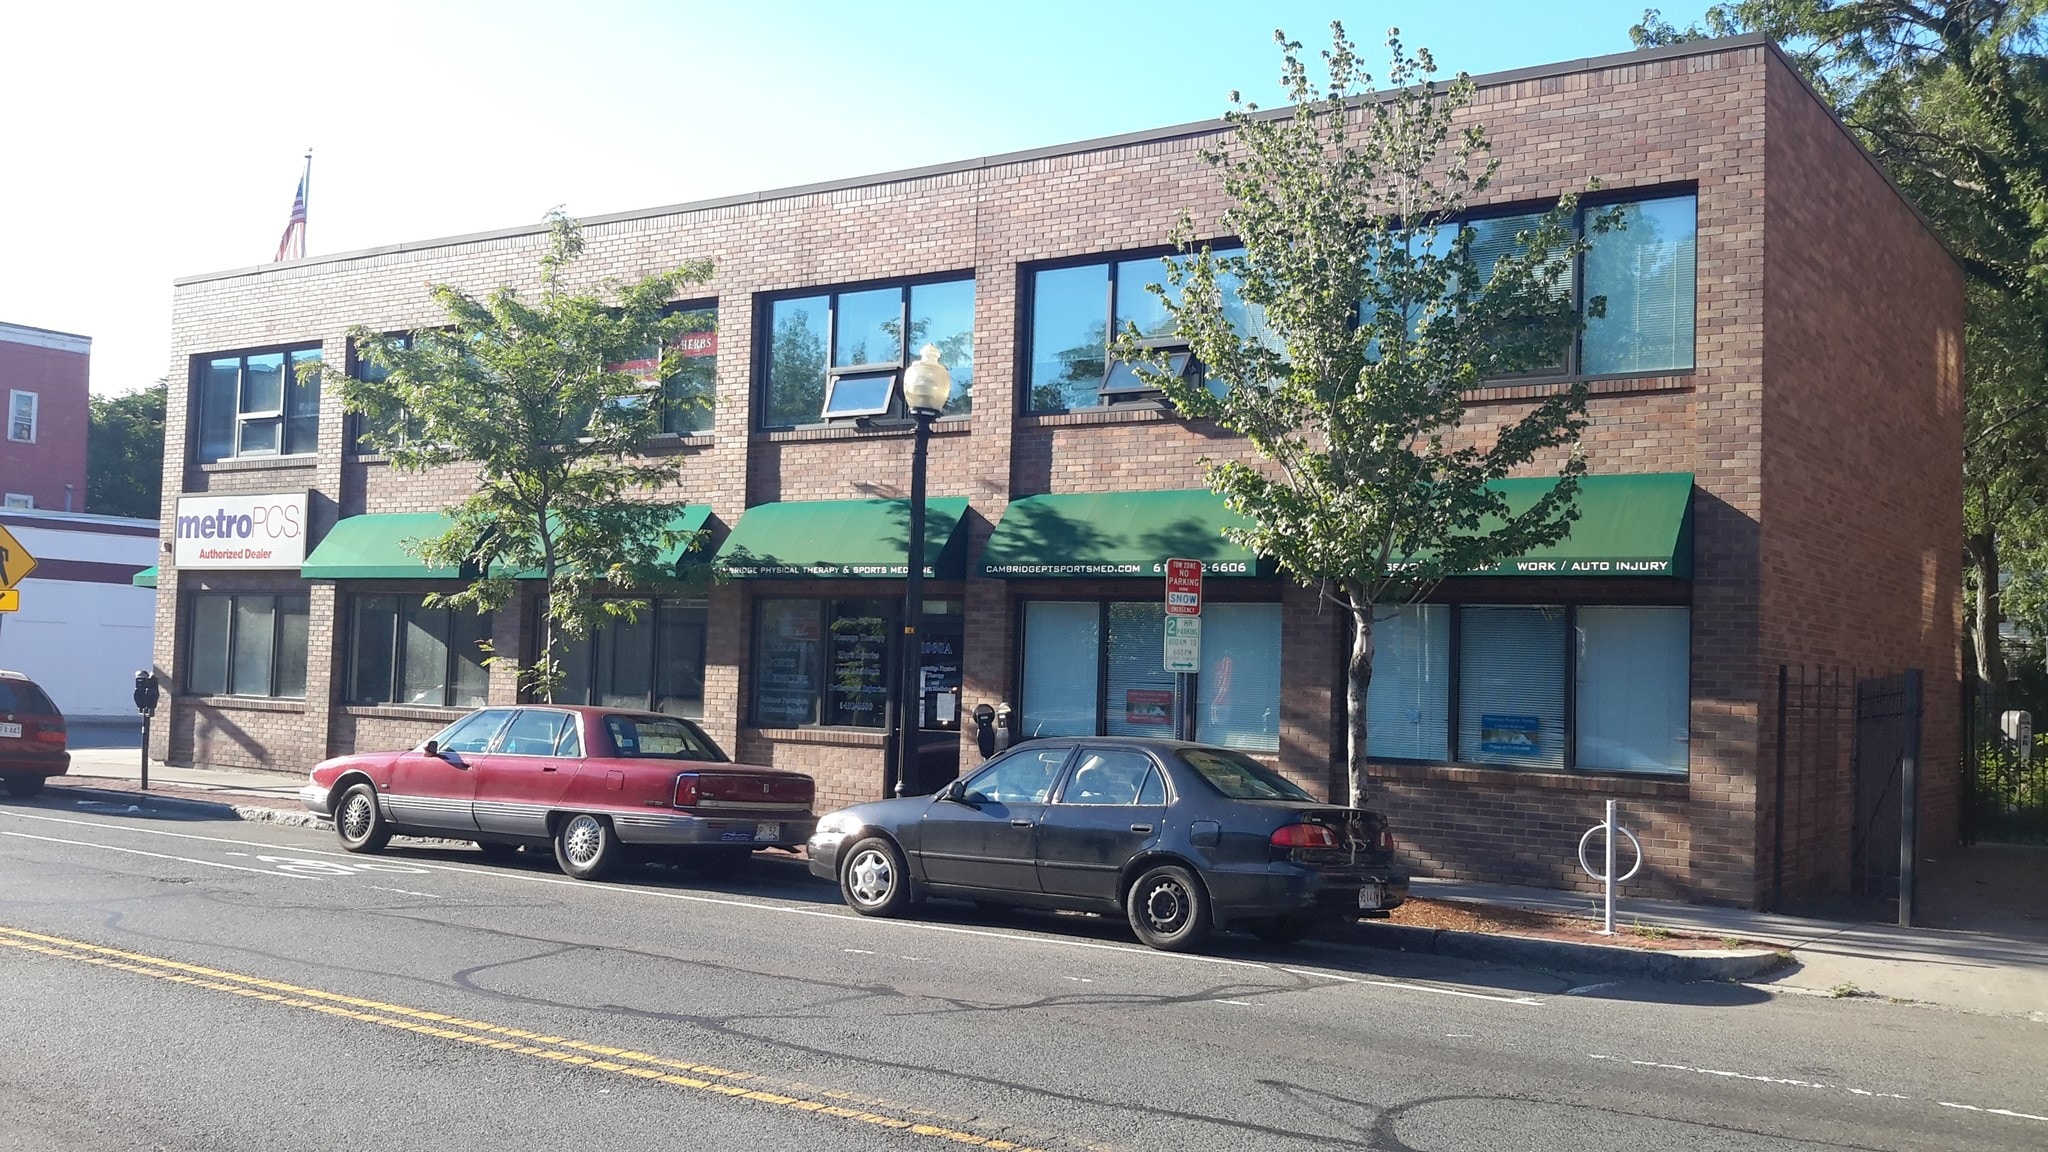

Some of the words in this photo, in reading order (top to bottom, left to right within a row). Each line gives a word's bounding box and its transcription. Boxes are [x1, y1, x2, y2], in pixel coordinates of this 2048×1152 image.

[680, 338, 711, 350] HERBS
[178, 505, 299, 538] metroPCS
[199, 549, 243, 559] Authorized
[245, 549, 272, 559] Dealer
[803, 566, 839, 574] THERAPY
[843, 565, 849, 574] &
[853, 566, 887, 574] SPORTS
[986, 565, 1140, 573] CAMBRIDGEPTSPORTSMED.COM
[1517, 562, 1556, 571] WORK
[1561, 560, 1566, 571] /
[1571, 562, 1610, 571] AUTO
[1616, 561, 1668, 571] INJURY
[1169, 577, 1199, 587] PARKING
[1170, 594, 1197, 604] SNOW
[1168, 620, 1175, 634] 2
